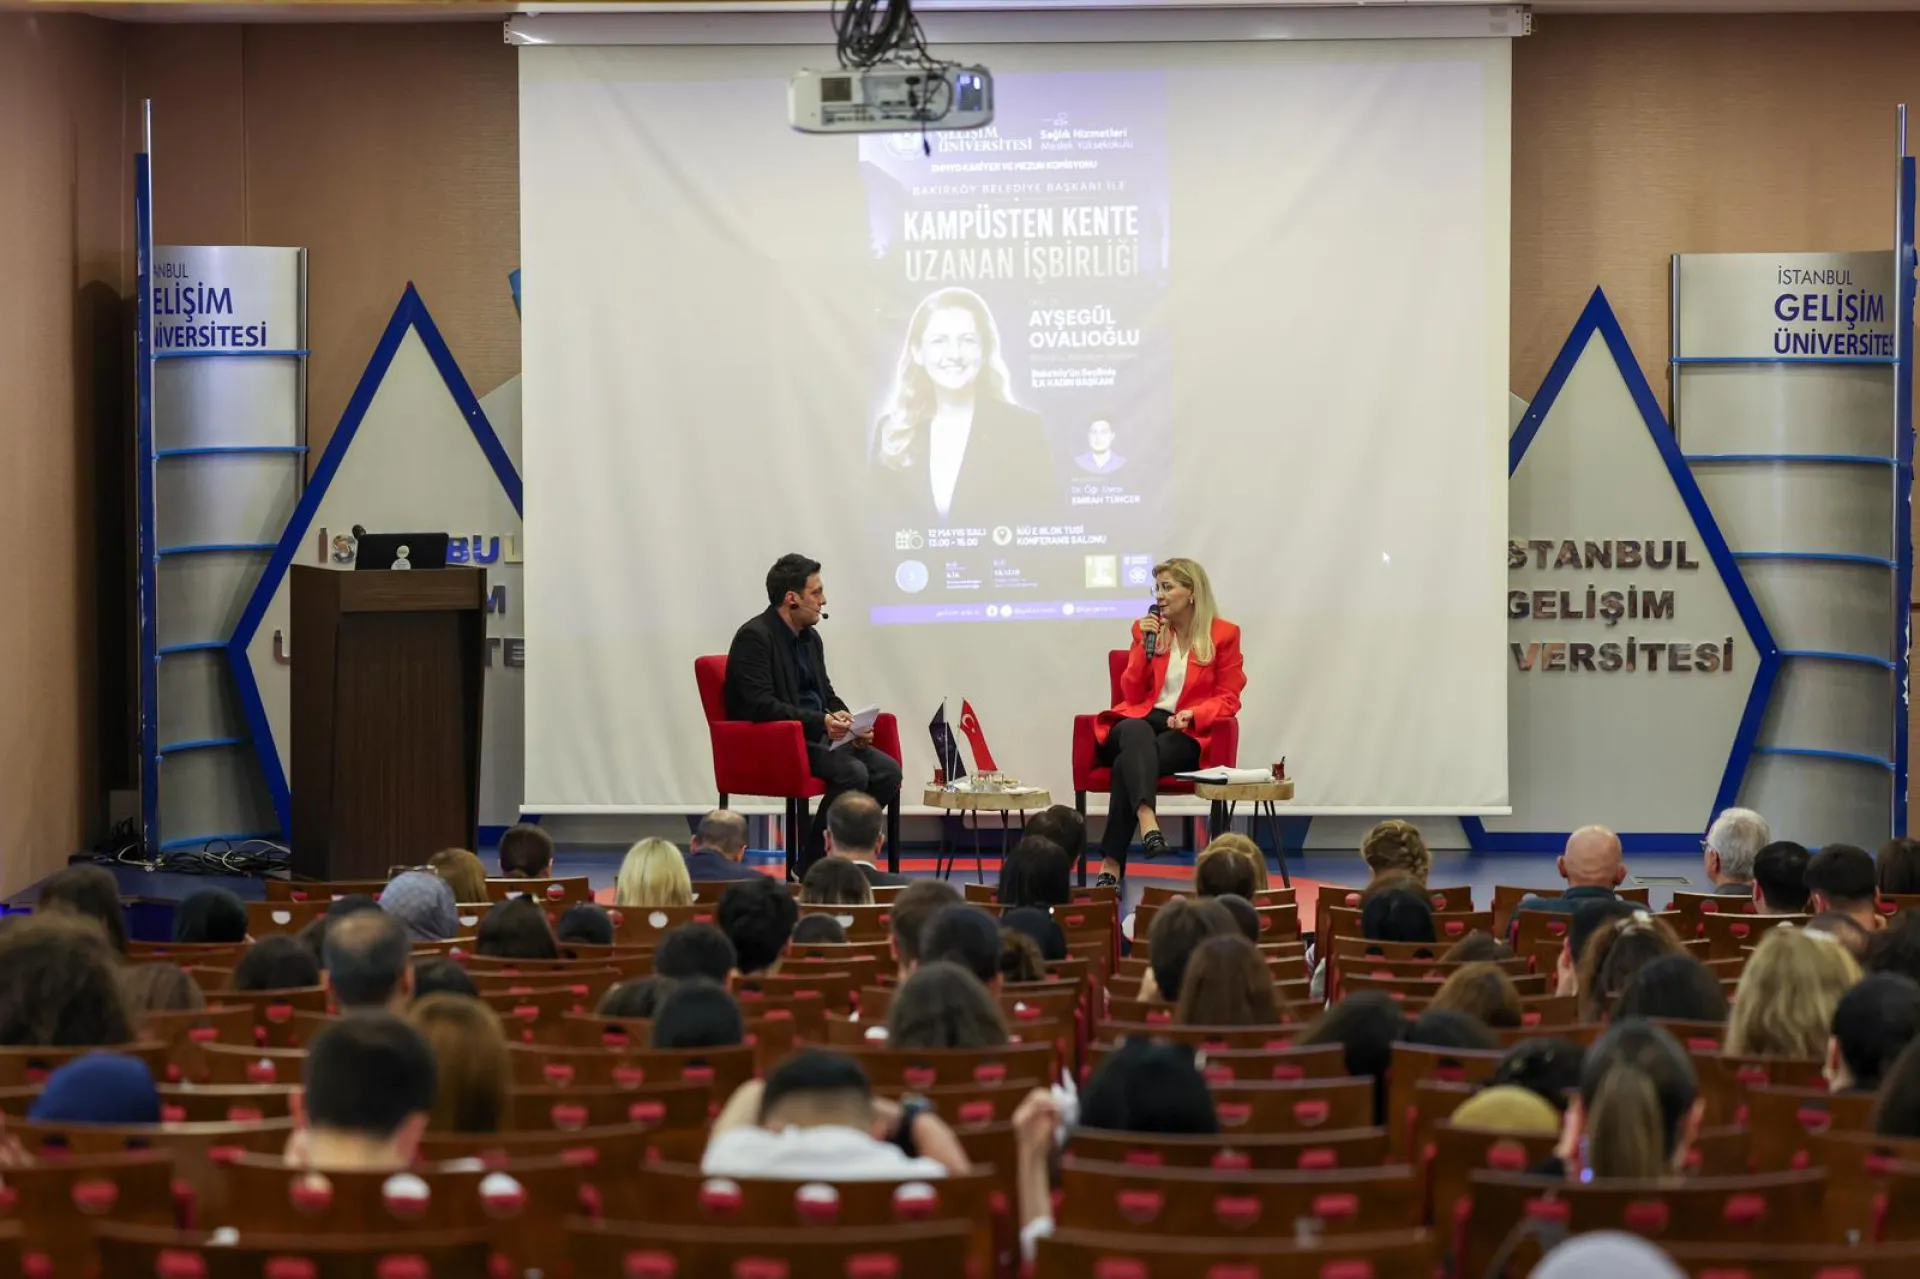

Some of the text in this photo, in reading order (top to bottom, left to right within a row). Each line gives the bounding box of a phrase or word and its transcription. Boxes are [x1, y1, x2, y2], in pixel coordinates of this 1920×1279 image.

[1039, 128, 1127, 141] Sağlık Hizmetleri
[982, 182, 1040, 194] BELEDİYE
[1047, 181, 1101, 193] BAŞKANI
[904, 203, 1139, 241] KAMPÜSTEN KENTE
[153, 263, 188, 279] ANBUL
[905, 238, 1139, 285] UZANAN İŞBİRLİĞİ
[1778, 266, 1853, 285] İSTANBUL
[153, 281, 233, 322] ELİŞİM
[1774, 288, 1884, 331] GELİŞİM
[1029, 304, 1116, 331] AYŞEGÜL
[154, 321, 266, 347] NİVERSİTESİ
[1029, 326, 1140, 348] OVALIOĞLU
[1774, 327, 1893, 356] ÜNİVERSİTES
[1508, 540, 1699, 570] STANBUL
[1508, 584, 1675, 627] GELİŞİM
[1511, 636, 1734, 672] VERSİTESİ
